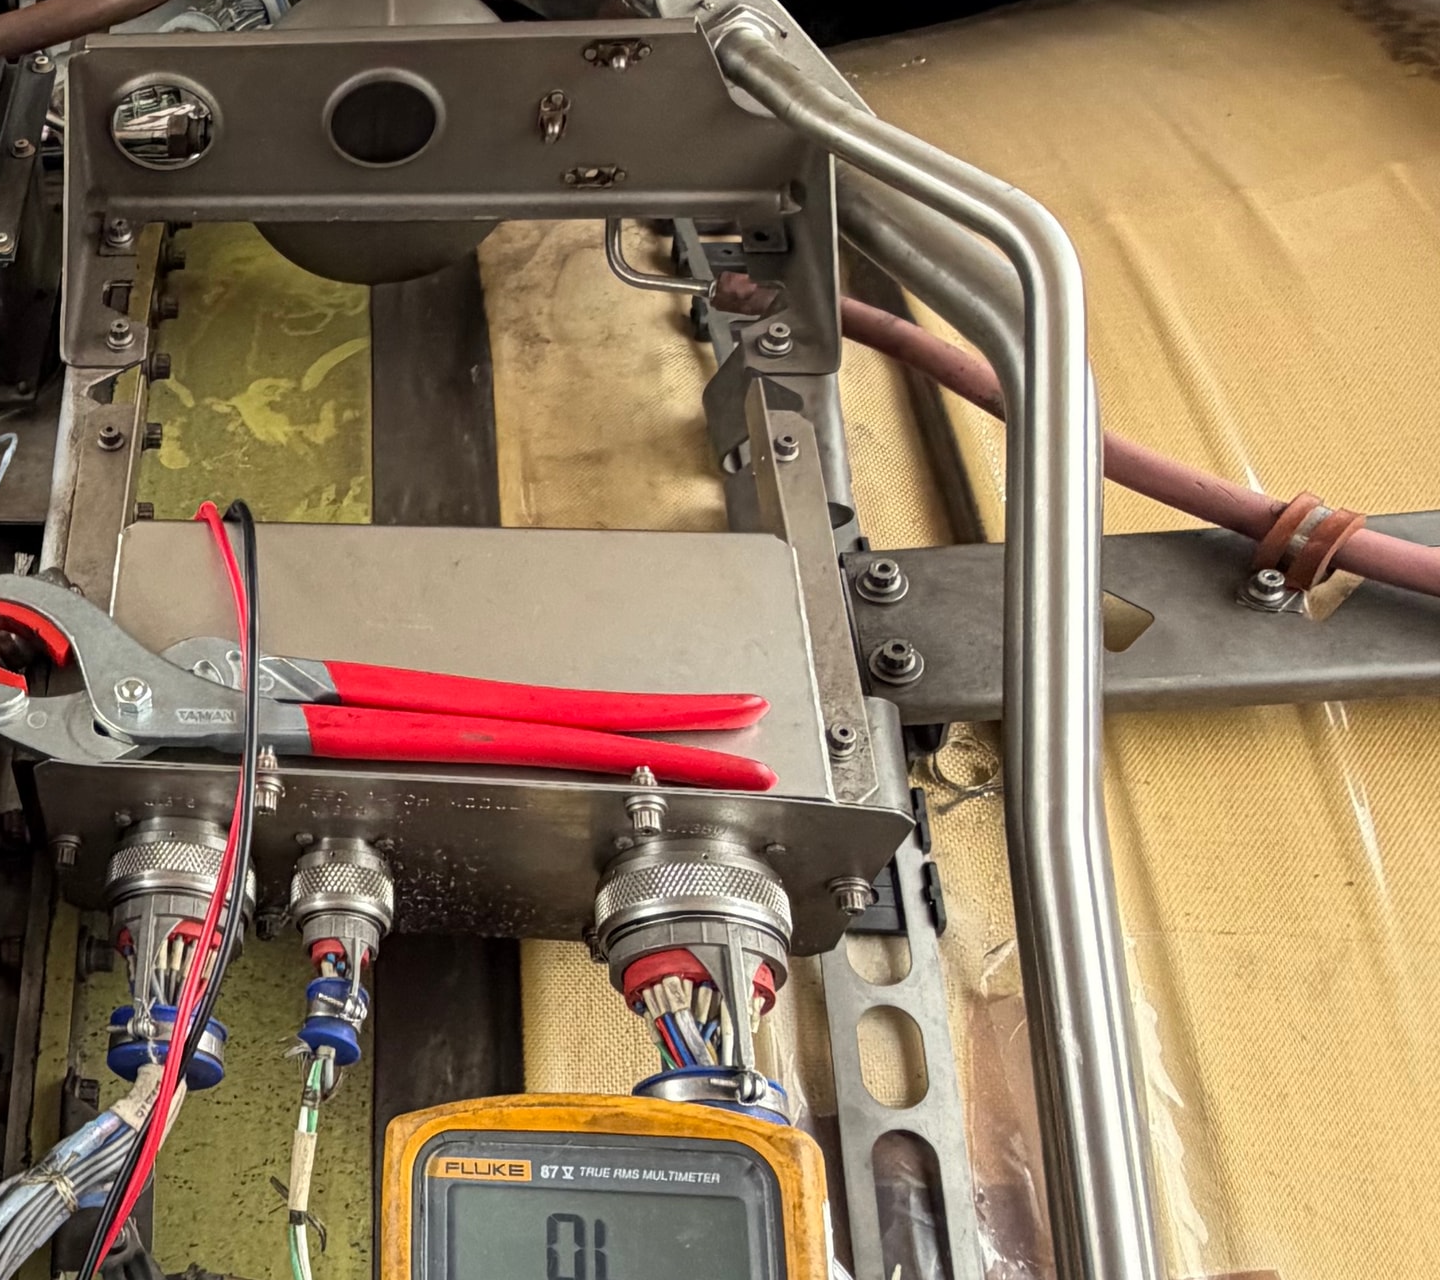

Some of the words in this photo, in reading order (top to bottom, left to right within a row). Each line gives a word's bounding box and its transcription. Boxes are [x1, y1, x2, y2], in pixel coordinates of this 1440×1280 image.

[445, 1161, 525, 1177] FLUKE
[540, 1164, 558, 1179] 87
[579, 1165, 611, 1179] TRUE
[613, 1167, 640, 1180] RMS
[642, 1168, 720, 1184] MULTIMETER
